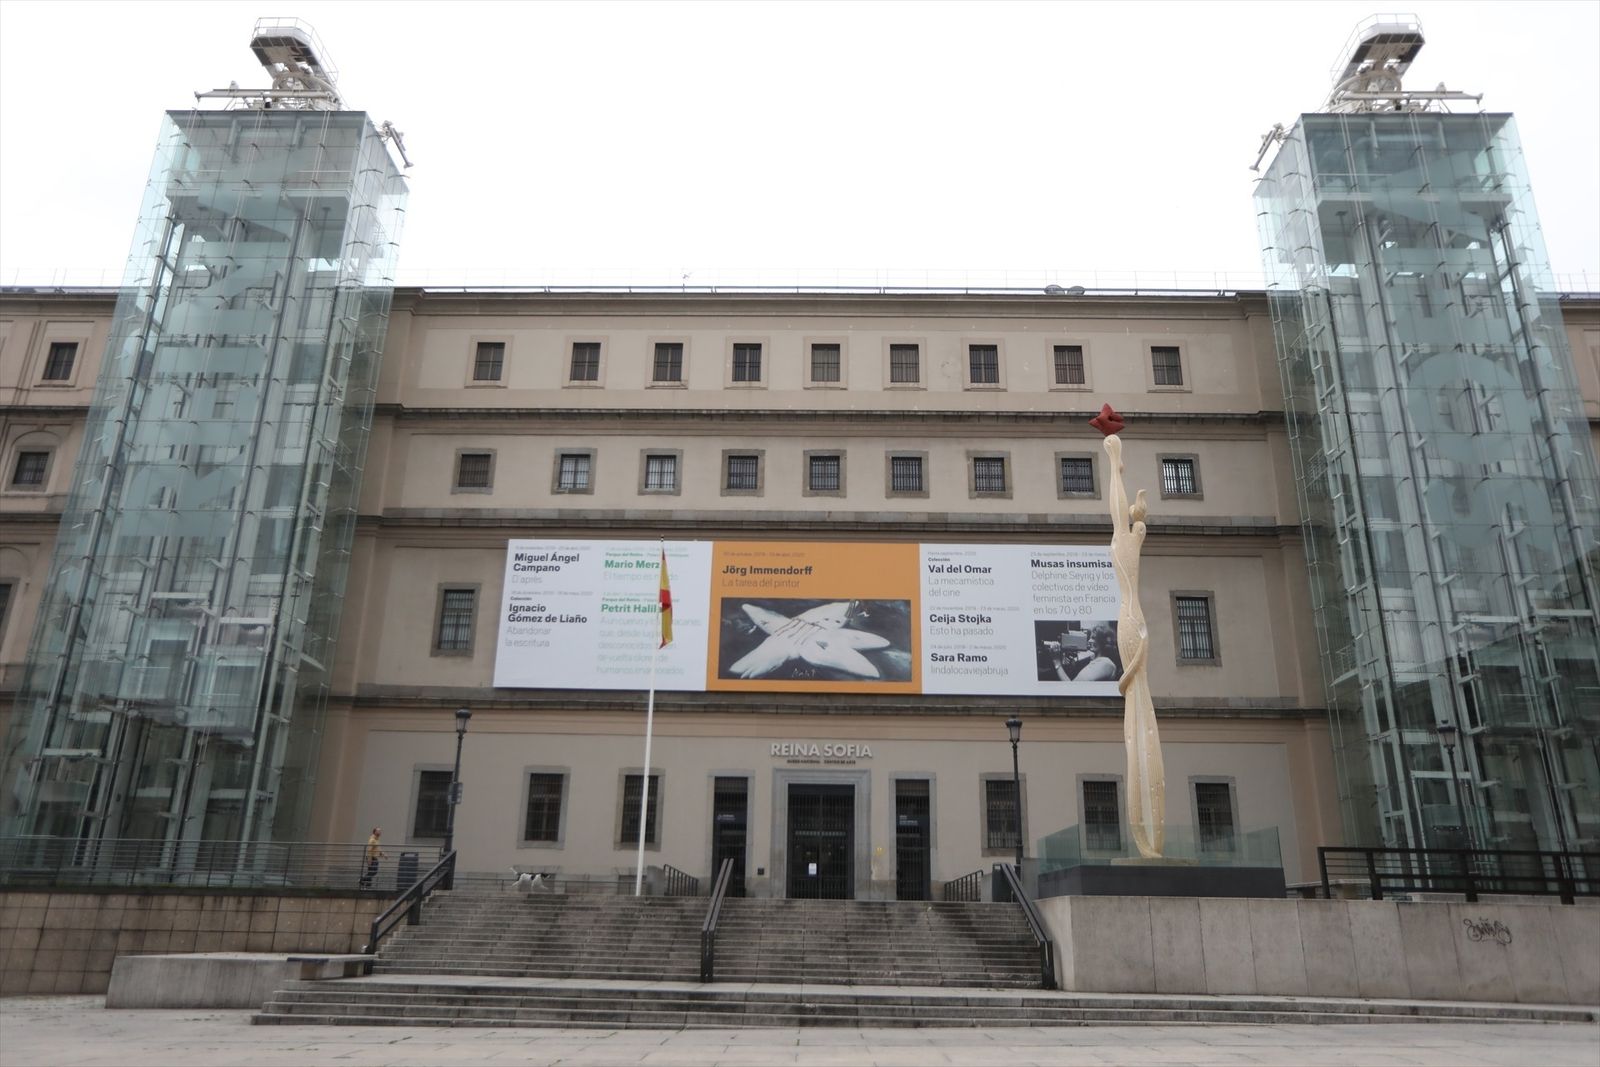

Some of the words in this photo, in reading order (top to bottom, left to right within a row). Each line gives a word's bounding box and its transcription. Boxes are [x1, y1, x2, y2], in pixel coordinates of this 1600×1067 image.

[514, 552, 549, 564] Miguel
[550, 551, 580, 564] Ángel
[513, 563, 561, 573] Campano
[604, 560, 633, 569] Mario
[636, 560, 660, 569] Merz
[1031, 559, 1065, 568] Musas
[1066, 559, 1115, 568] insumisa
[722, 565, 747, 576] Jörg
[750, 565, 813, 575] Immendorff
[928, 564, 944, 574] Val
[946, 564, 962, 573] del
[963, 565, 992, 574] Omar
[928, 576, 939, 585] La
[1032, 570, 1068, 581] Delphine
[1069, 571, 1095, 581] Seyrig
[1095, 573, 1101, 582] y
[1102, 571, 1114, 580] los
[722, 578, 733, 587] La
[735, 579, 758, 587] tarea
[759, 578, 773, 587] del
[774, 579, 800, 588] pintor
[1032, 583, 1074, 591] colectivos
[1075, 583, 1086, 591] de
[929, 587, 941, 597] del
[942, 588, 961, 597] cine
[1033, 594, 1072, 603] feminista
[1085, 594, 1116, 603] Francia
[509, 603, 547, 614] Ignacio
[601, 604, 631, 613] Petrit
[633, 604, 664, 613] Halil
[1033, 607, 1044, 615] en
[1045, 605, 1058, 614] los
[1059, 605, 1071, 615] 70
[1072, 608, 1078, 616] y
[1078, 605, 1093, 615] 80
[508, 613, 543, 623] Gómez
[545, 614, 558, 623] de
[560, 614, 588, 623] Liaño
[929, 614, 956, 625] Ceija
[958, 614, 992, 625] Stojka
[507, 626, 552, 635] Abandonar
[930, 626, 949, 635] Esto
[951, 626, 962, 635] ha
[963, 626, 994, 636] pasado
[513, 638, 551, 647] escritura
[930, 652, 955, 662] Sara
[957, 652, 988, 662] Ramo
[771, 743, 820, 757] REINA
[823, 743, 873, 757] SOFIA
